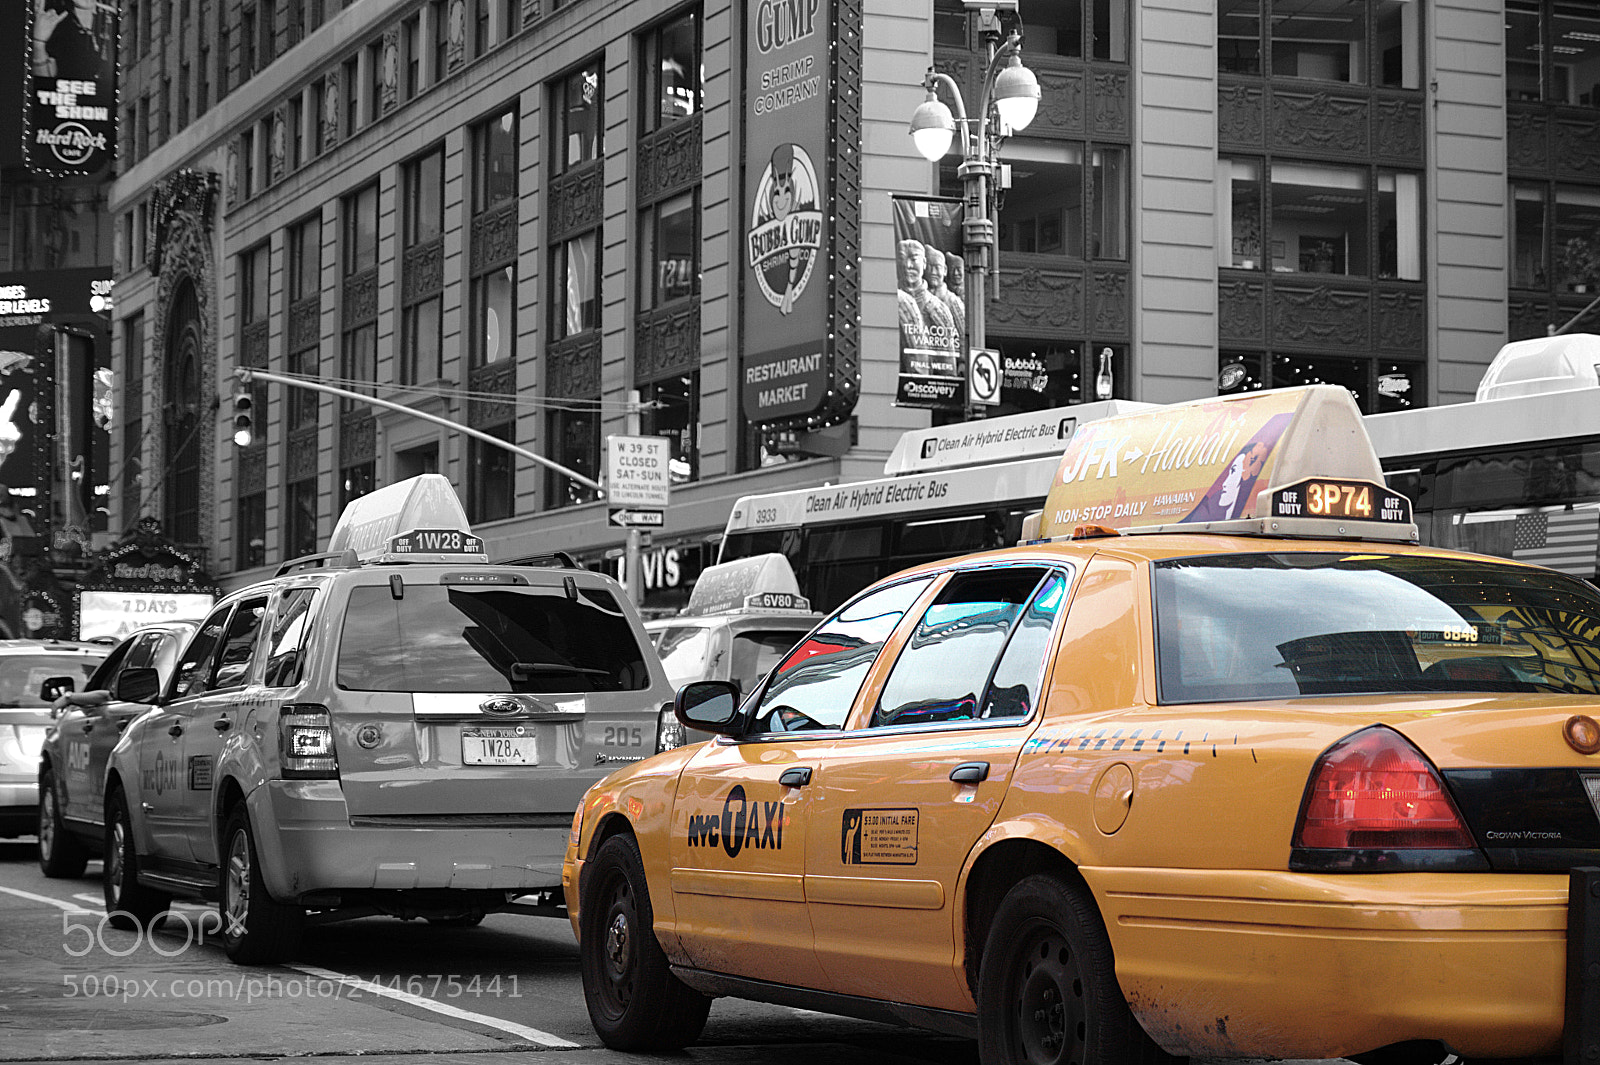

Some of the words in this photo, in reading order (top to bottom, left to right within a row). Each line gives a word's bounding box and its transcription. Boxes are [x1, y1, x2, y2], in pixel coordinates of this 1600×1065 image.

[756, 0, 820, 54] GUMP
[761, 55, 814, 91] SHRIMP
[56, 79, 97, 96] SEE
[754, 75, 820, 116] COMPANY
[36, 90, 78, 107] THE
[55, 105, 109, 121] SHOW
[36, 129, 72, 146] Hard
[72, 131, 107, 151] Rock
[750, 222, 788, 263] BUBBA
[790, 214, 822, 245] GUMP
[763, 251, 789, 273] SHRIMP
[13, 298, 50, 314] LEVELS
[913, 334, 960, 349] WARRIORS
[746, 353, 822, 384] RESTAURANT
[758, 383, 808, 408] MARKET
[938, 438, 963, 452] Clean
[962, 436, 974, 450] Air
[975, 430, 1003, 450] Hybrid
[1004, 425, 1038, 443] Electric
[1038, 422, 1056, 437] Bus
[617, 443, 625, 452] W
[630, 443, 643, 453] 39
[647, 444, 659, 455] ST
[1062, 434, 1128, 483] JFK
[1140, 413, 1247, 474] Hawaii
[619, 456, 658, 468] CLOSED
[806, 493, 831, 513] Clean
[832, 490, 848, 510] Air
[849, 486, 883, 509] Hybrid
[885, 480, 925, 504] Electric
[927, 479, 948, 499] Bus
[1152, 491, 1197, 507] HAWAIIAN
[1282, 491, 1298, 503] OFF
[1307, 483, 1372, 516] 3P74
[1384, 497, 1400, 509] OFF
[756, 508, 777, 524] 3933
[1054, 504, 1112, 524] NON-STOP
[1113, 501, 1148, 518] DAILY
[1279, 502, 1302, 515] DUTY
[1381, 508, 1403, 521] DUTY
[398, 538, 409, 546] OFF
[416, 532, 461, 550] 1W28
[465, 538, 477, 546] OFF
[618, 546, 680, 590] LVI'S
[122, 600, 131, 612] 7
[134, 599, 178, 614] DAYS
[764, 593, 792, 607] 6V80
[481, 729, 497, 737] NEW
[500, 729, 519, 738] YORK
[604, 726, 642, 747] 205
[688, 814, 720, 848] NYC
[722, 788, 786, 856] TAXI
[864, 815, 879, 826] $3.00
[880, 815, 900, 826] INITIAL
[901, 815, 916, 826] FARE
